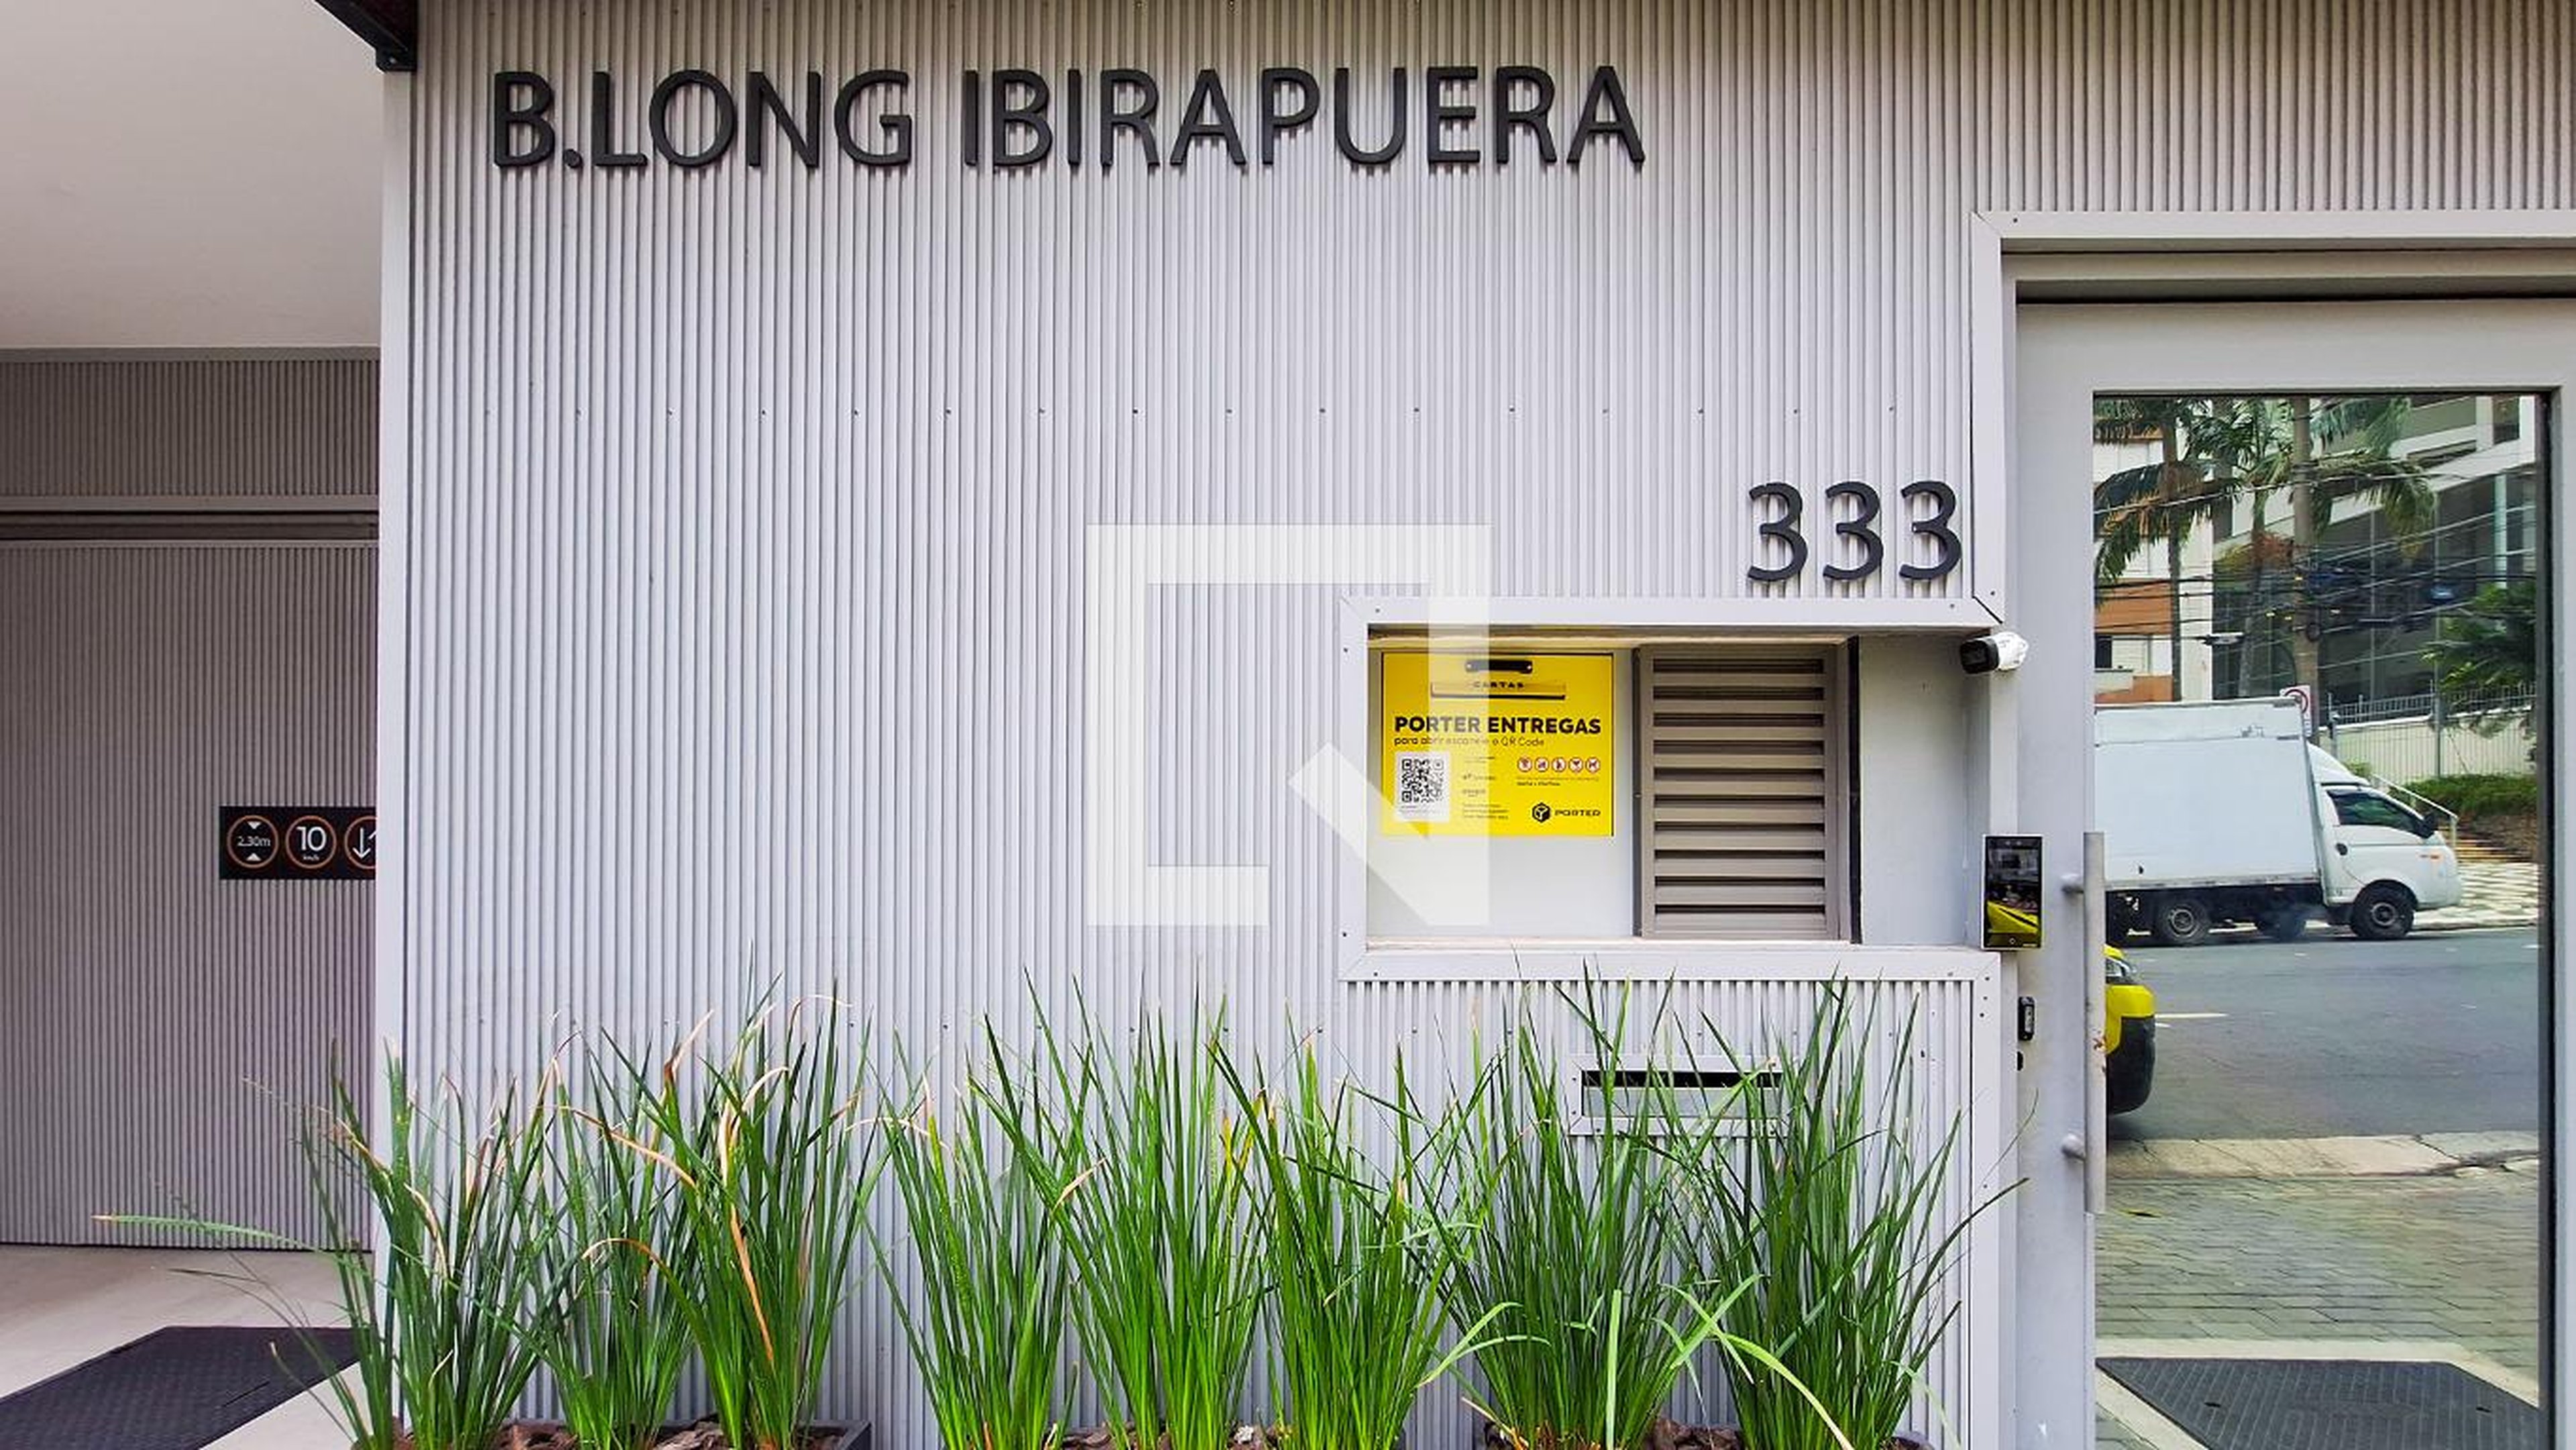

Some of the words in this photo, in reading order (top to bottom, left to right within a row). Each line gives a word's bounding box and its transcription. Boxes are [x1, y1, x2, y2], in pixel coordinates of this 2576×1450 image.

[493, 69, 913, 168] B.LONG
[962, 66, 1645, 166] IBIRAPUERA
[1747, 480, 1963, 582] 333
[1395, 716, 1481, 733] PORTER
[1488, 717, 1601, 734] ENTREGAS
[1394, 737, 1418, 746] para
[1501, 737, 1516, 746] QR
[1518, 737, 1545, 746] Code
[1554, 809, 1601, 817] PORTER
[296, 826, 327, 851] 10
